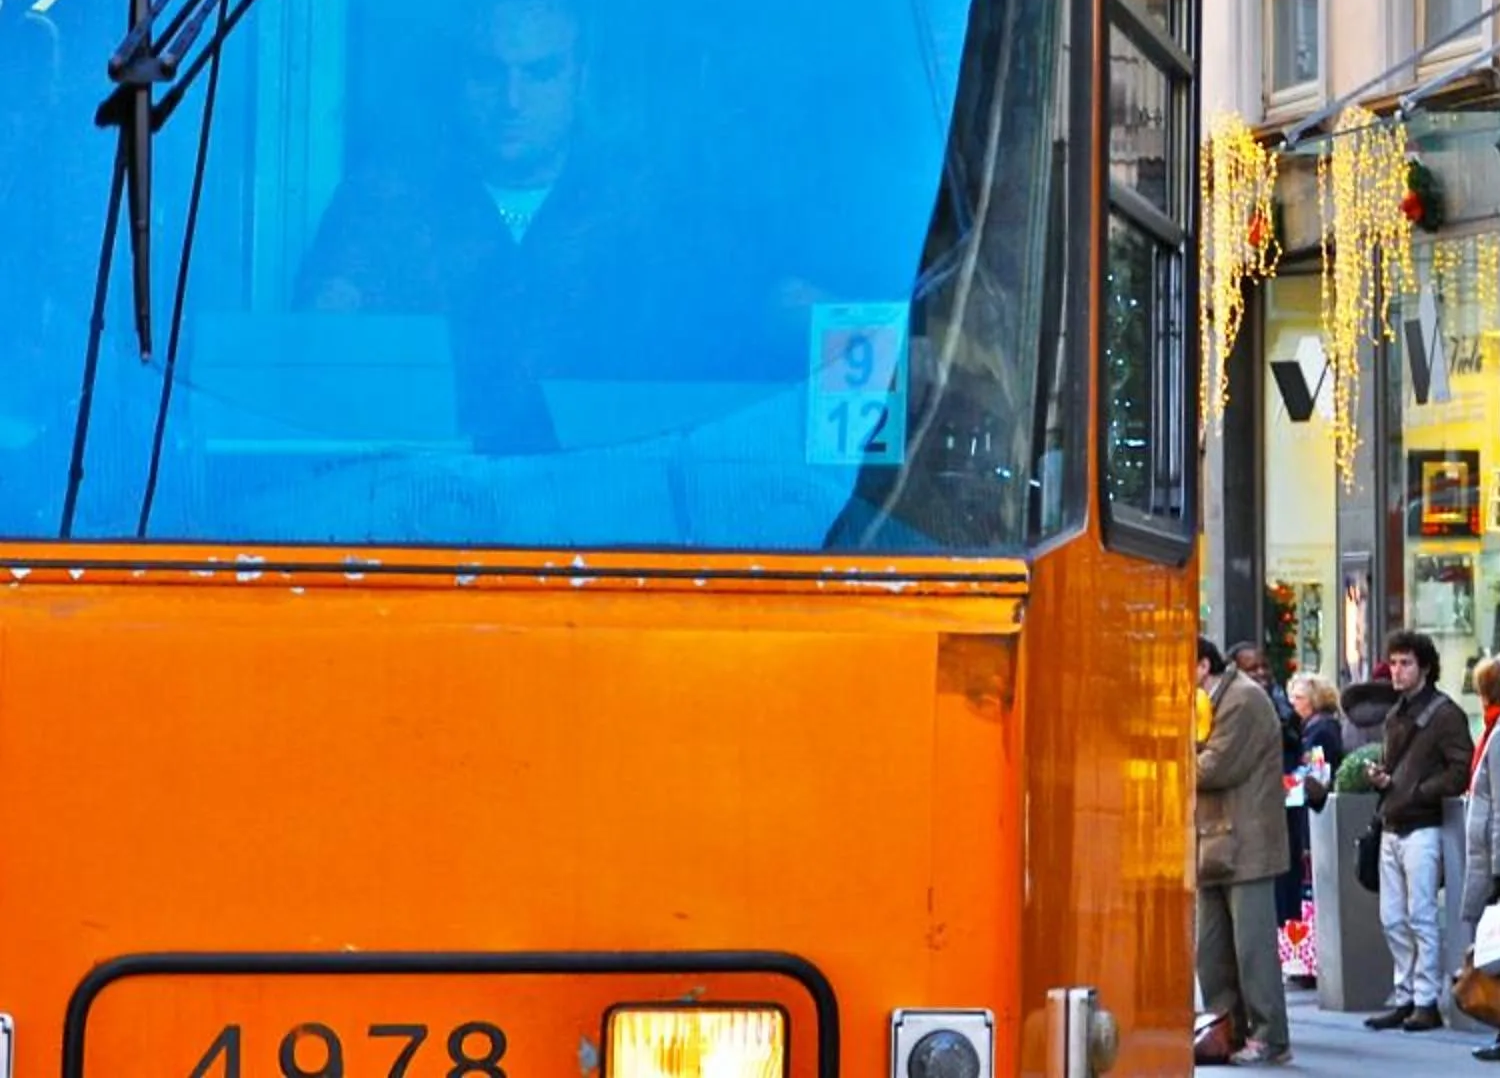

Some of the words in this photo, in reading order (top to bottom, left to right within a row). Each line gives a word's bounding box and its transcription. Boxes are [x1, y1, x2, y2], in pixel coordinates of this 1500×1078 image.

[844, 335, 874, 387] 9
[827, 400, 889, 453] 12
[187, 1021, 509, 1078] 4978
